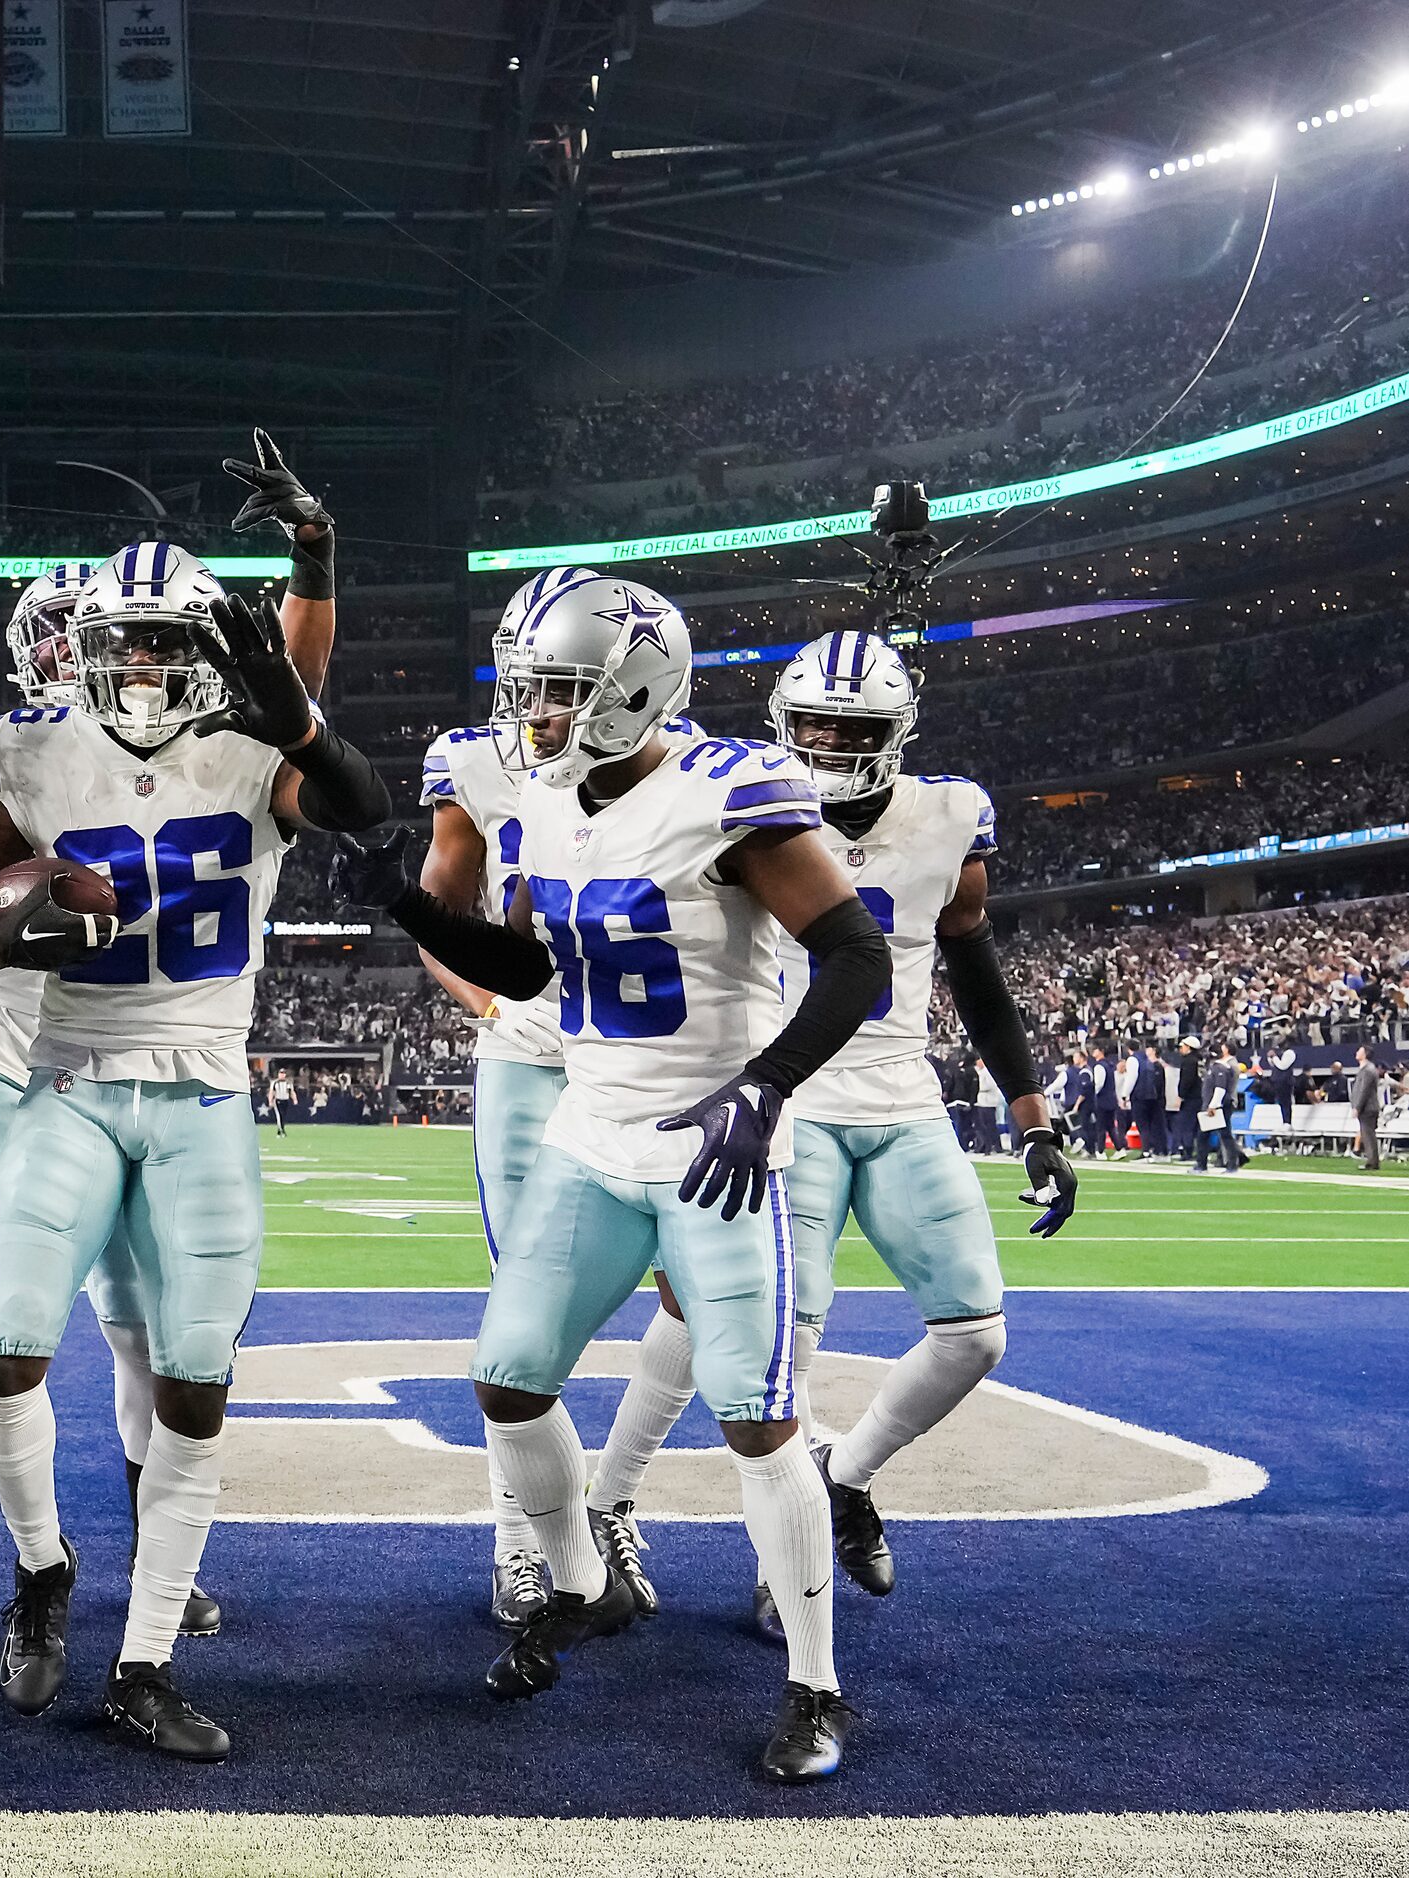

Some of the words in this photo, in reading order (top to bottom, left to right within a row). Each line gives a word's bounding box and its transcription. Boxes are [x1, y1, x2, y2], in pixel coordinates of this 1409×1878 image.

[123, 26, 166, 36] DALLAS
[3, 37, 47, 46] OWBOYS
[118, 37, 171, 47] COWBOYS
[1265, 419, 1291, 441] THE
[1296, 399, 1359, 431] OFFICIAL
[929, 497, 982, 517] DALLAS
[987, 480, 1062, 506] COWBOYS
[612, 544, 641, 559] THE
[643, 537, 709, 557] OFFICIAL
[712, 527, 789, 549] CLEANING
[792, 515, 868, 538] COMPANY
[12, 561, 33, 575] OF
[124, 602, 160, 610] COWBOYS
[53, 811, 253, 984] 26
[273, 921, 372, 936] Blockchain.com
